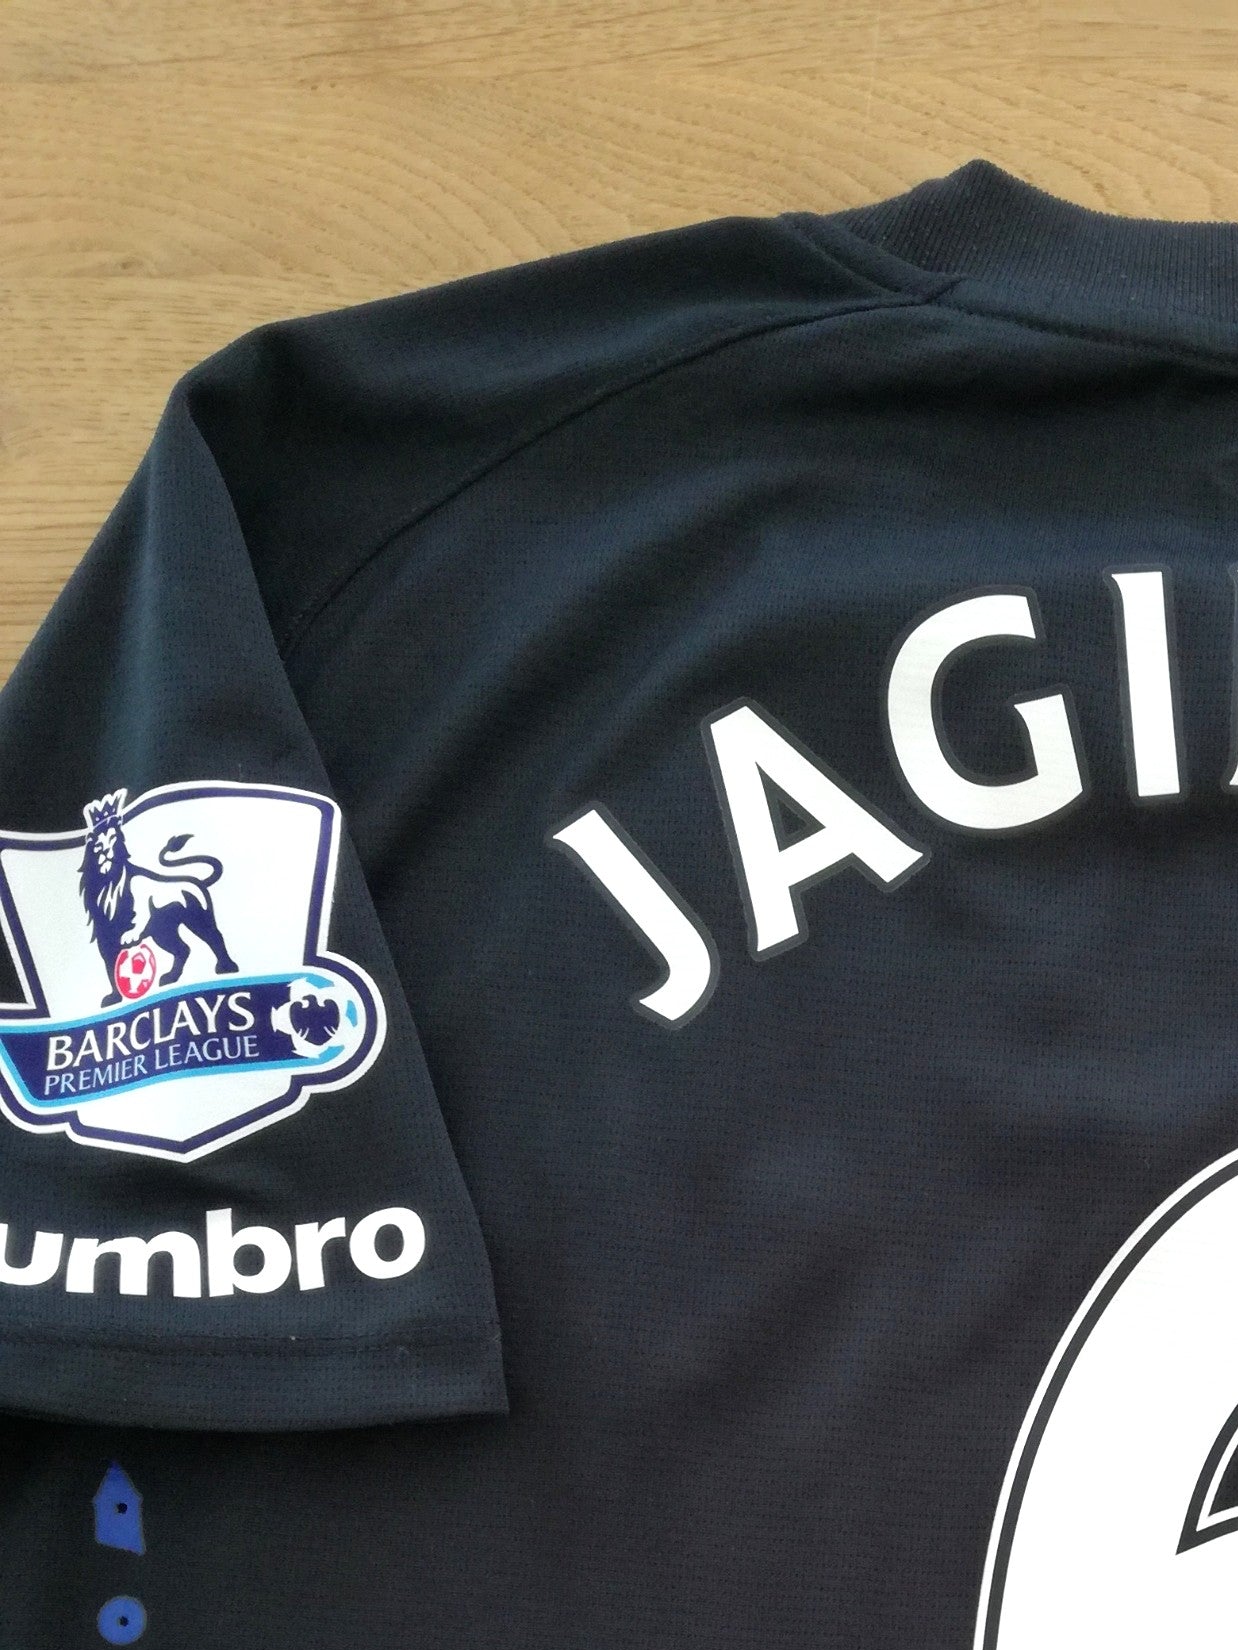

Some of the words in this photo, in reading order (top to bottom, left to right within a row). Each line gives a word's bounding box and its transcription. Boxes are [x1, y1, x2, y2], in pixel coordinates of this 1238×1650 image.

[44, 1055, 148, 1095] PREMIER
[154, 1035, 260, 1070] LEAGUE
[46, 992, 255, 1071] BARCLAYS
[0, 1206, 426, 1298] umbro
